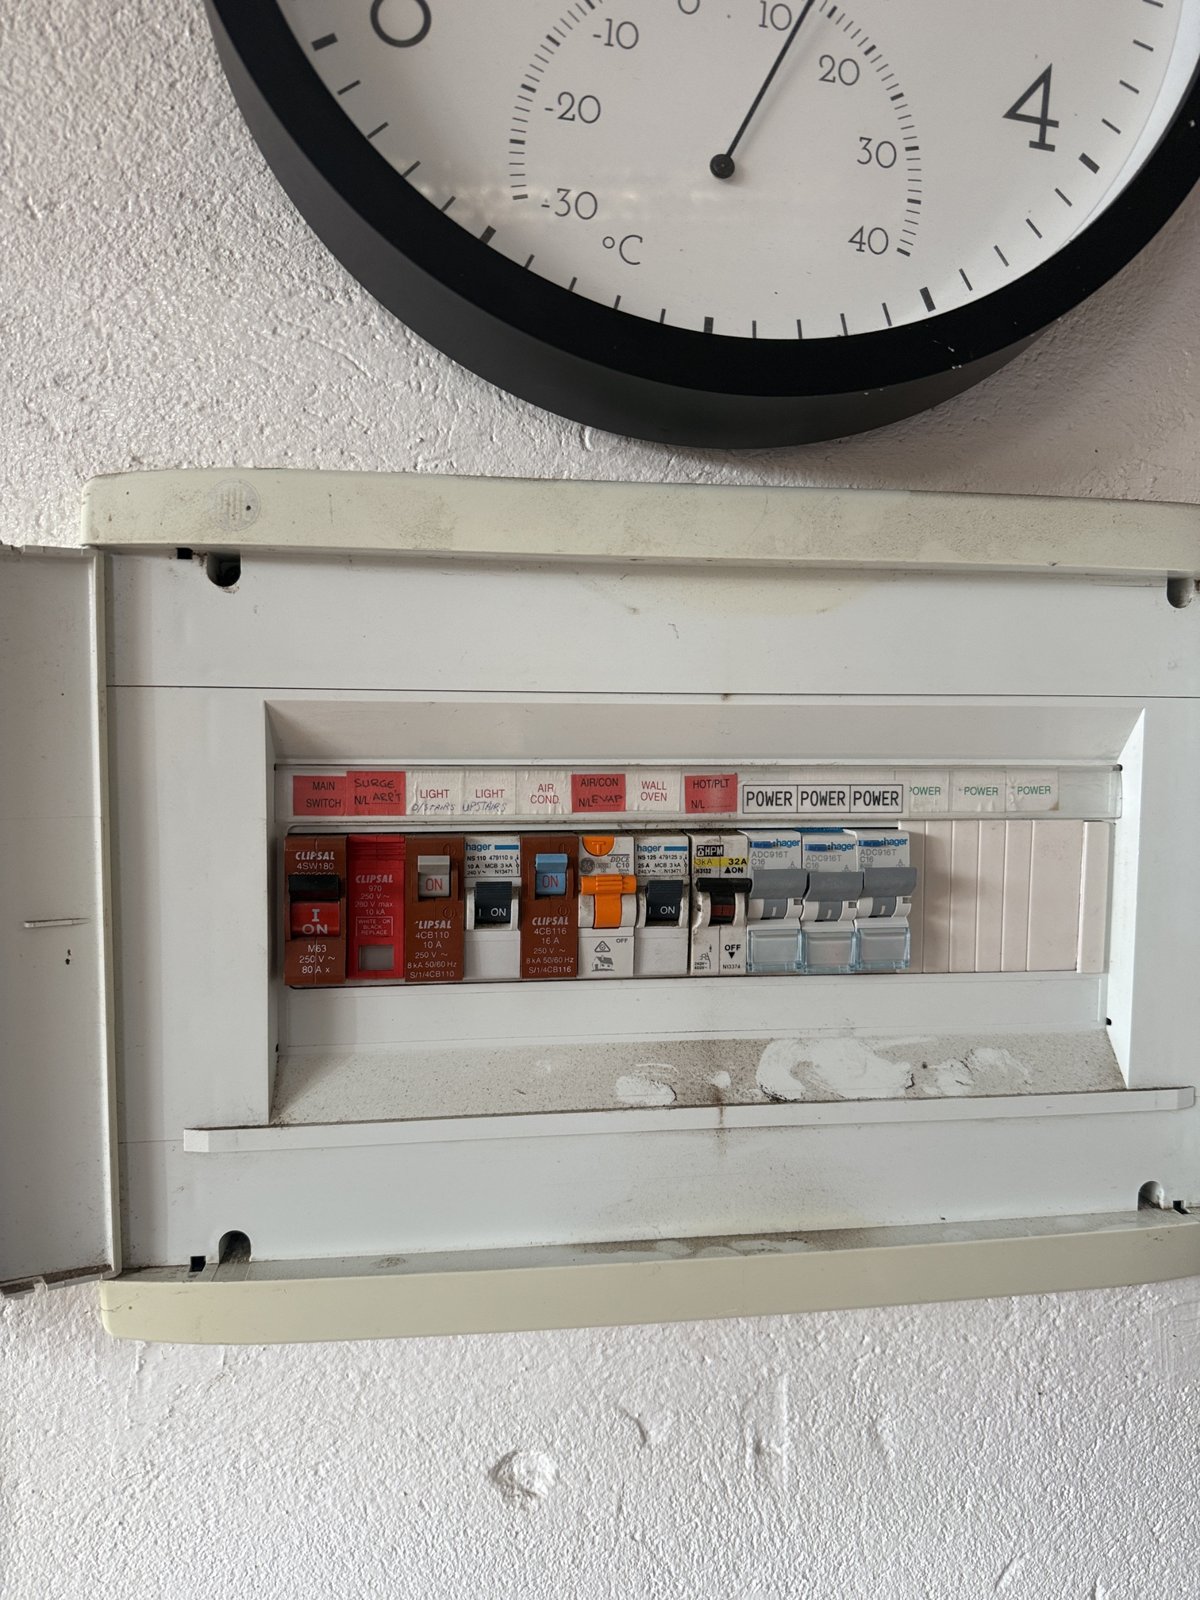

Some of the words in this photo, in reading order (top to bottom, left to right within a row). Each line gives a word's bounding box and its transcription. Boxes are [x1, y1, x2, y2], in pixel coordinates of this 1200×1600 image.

[759, 0, 792, 31] 10
[592, 18, 639, 49] -10
[818, 54, 860, 86] 20
[545, 91, 601, 124] -20
[1001, 63, 1060, 152] 4
[856, 136, 897, 169] 30
[541, 187, 598, 221] -30
[849, 226, 889, 255] 40
[312, 781, 335, 791] MAIN
[353, 778, 395, 789] SURGE
[580, 778, 619, 787] AIR/CON
[641, 781, 667, 790] WALL
[692, 779, 729, 789] HOT/PLT
[537, 784, 554, 792] AIR
[964, 786, 998, 796] POWER
[1017, 785, 1051, 795] POWER
[420, 789, 450, 799] LIGHT
[475, 789, 505, 799] LIGHT
[592, 794, 624, 804] EVAP
[640, 792, 667, 801] OVEN
[747, 790, 793, 807] POWER
[800, 790, 846, 807] POWER
[853, 790, 899, 807] POWER
[306, 799, 342, 808] SWITCH
[354, 795, 369, 805] N/L
[578, 798, 592, 807] N/L
[691, 800, 705, 809] N/L
[462, 801, 508, 812] UPSTAIRS
[466, 842, 492, 852] hager
[592, 840, 607, 854] T
[636, 844, 662, 854] hager
[705, 846, 723, 856] HPM
[296, 851, 335, 860] CLIPSAL
[752, 850, 788, 858] ADC916T
[296, 862, 334, 870] 4SW180
[356, 874, 394, 884] CLIPSAL
[542, 876, 559, 888] ON
[425, 878, 443, 891] ON
[490, 908, 506, 916] ON
[660, 906, 676, 914] ON
[415, 920, 452, 929] LIPSAL
[532, 916, 568, 926] CLIPSAL
[302, 924, 328, 934] ON
[416, 931, 450, 939] 4CB110
[424, 940, 433, 949] 10
[542, 937, 551, 945] 16
[308, 944, 327, 952] M63
[299, 956, 316, 964] 250
[302, 966, 312, 974] 80
